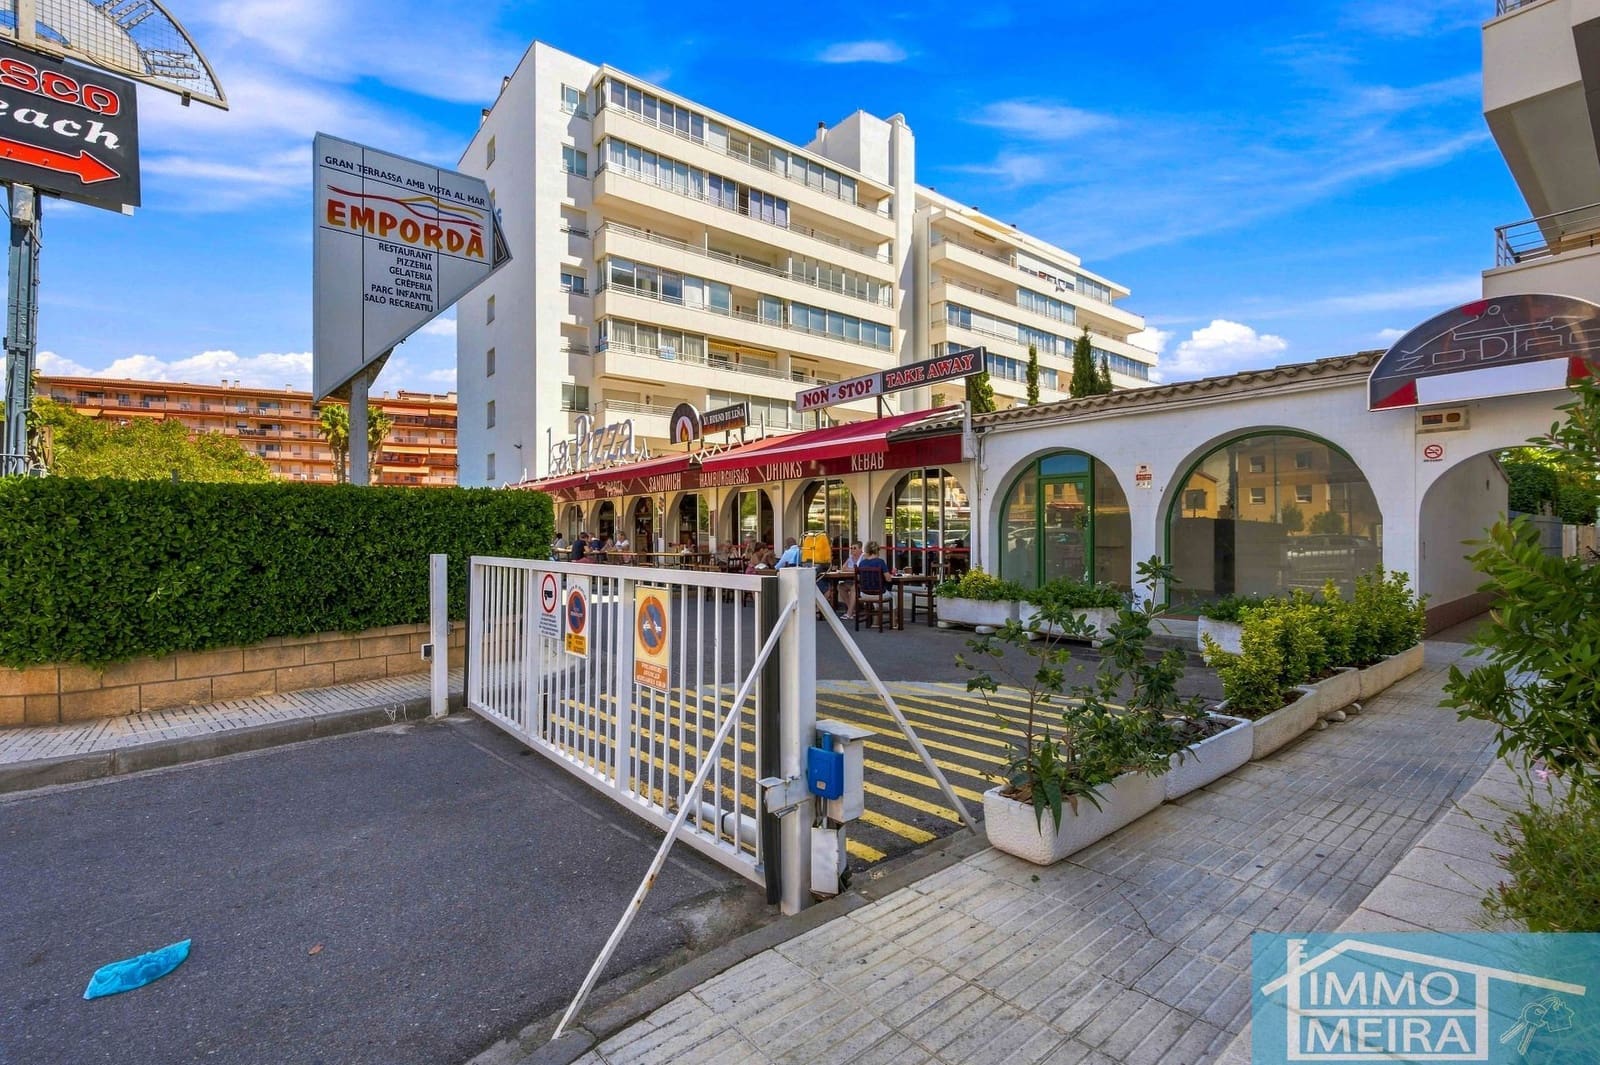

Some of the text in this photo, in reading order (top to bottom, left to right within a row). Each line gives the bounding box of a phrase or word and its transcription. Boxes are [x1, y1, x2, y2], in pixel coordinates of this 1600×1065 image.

[325, 156, 485, 206] GRAN TERRASSA AMB VISTA AL MAR
[378, 242, 432, 261] RESTAURANT
[389, 266, 432, 281] GELATERIA
[396, 257, 433, 271] PIZZERIA
[371, 284, 433, 302] PARC INFANTIL
[389, 297, 433, 312] RECREATIU
[885, 353, 975, 388] TAKE AWAY
[803, 390, 829, 407] NON
[838, 378, 873, 400] STOP
[766, 460, 802, 481] DRINKS
[851, 451, 885, 472] KEBAB
[648, 472, 682, 493] SANDWICH
[699, 468, 750, 488] HAMBURGUESAS
